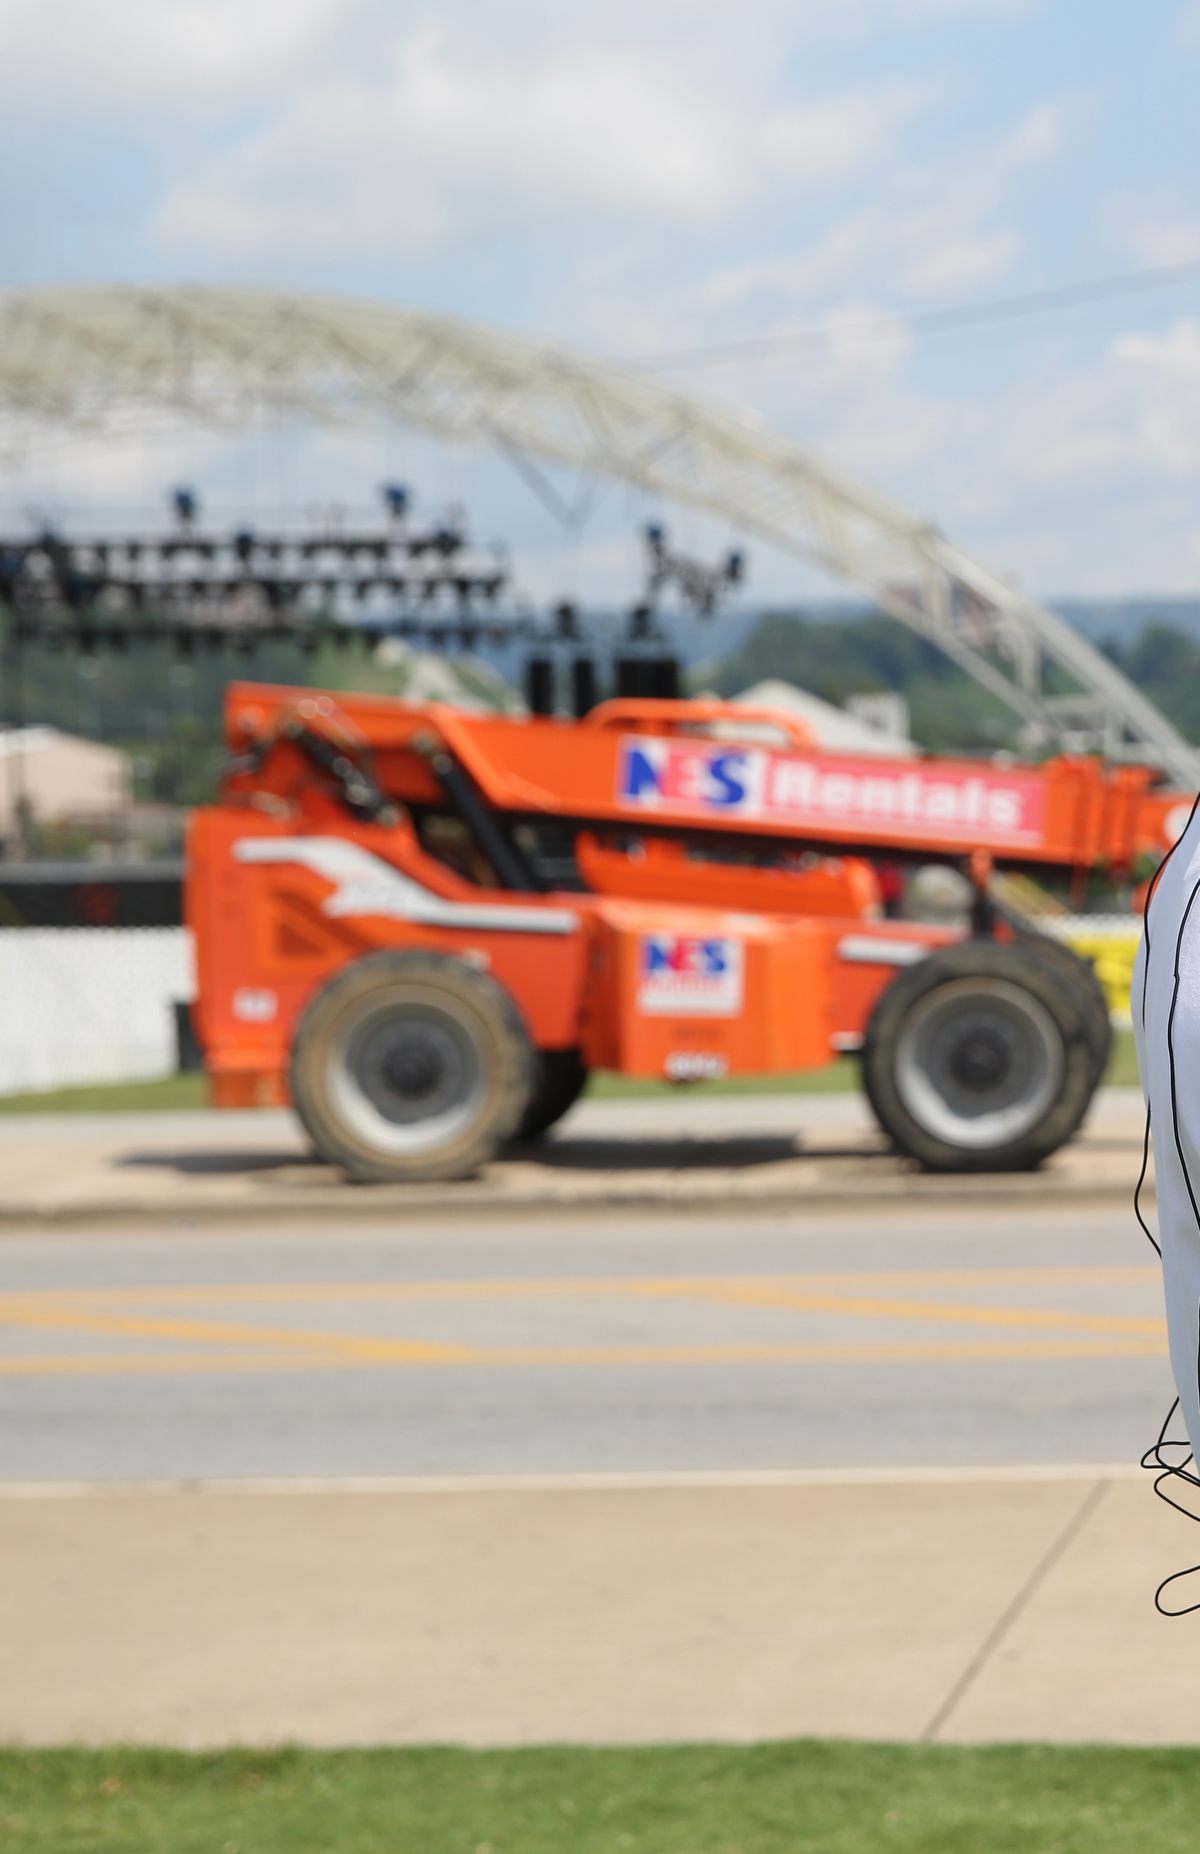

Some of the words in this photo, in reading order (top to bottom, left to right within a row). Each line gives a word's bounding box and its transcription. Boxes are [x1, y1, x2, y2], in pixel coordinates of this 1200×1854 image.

[622, 743, 748, 810] NES
[773, 758, 1022, 828] Rentals
[641, 936, 726, 978] NES
